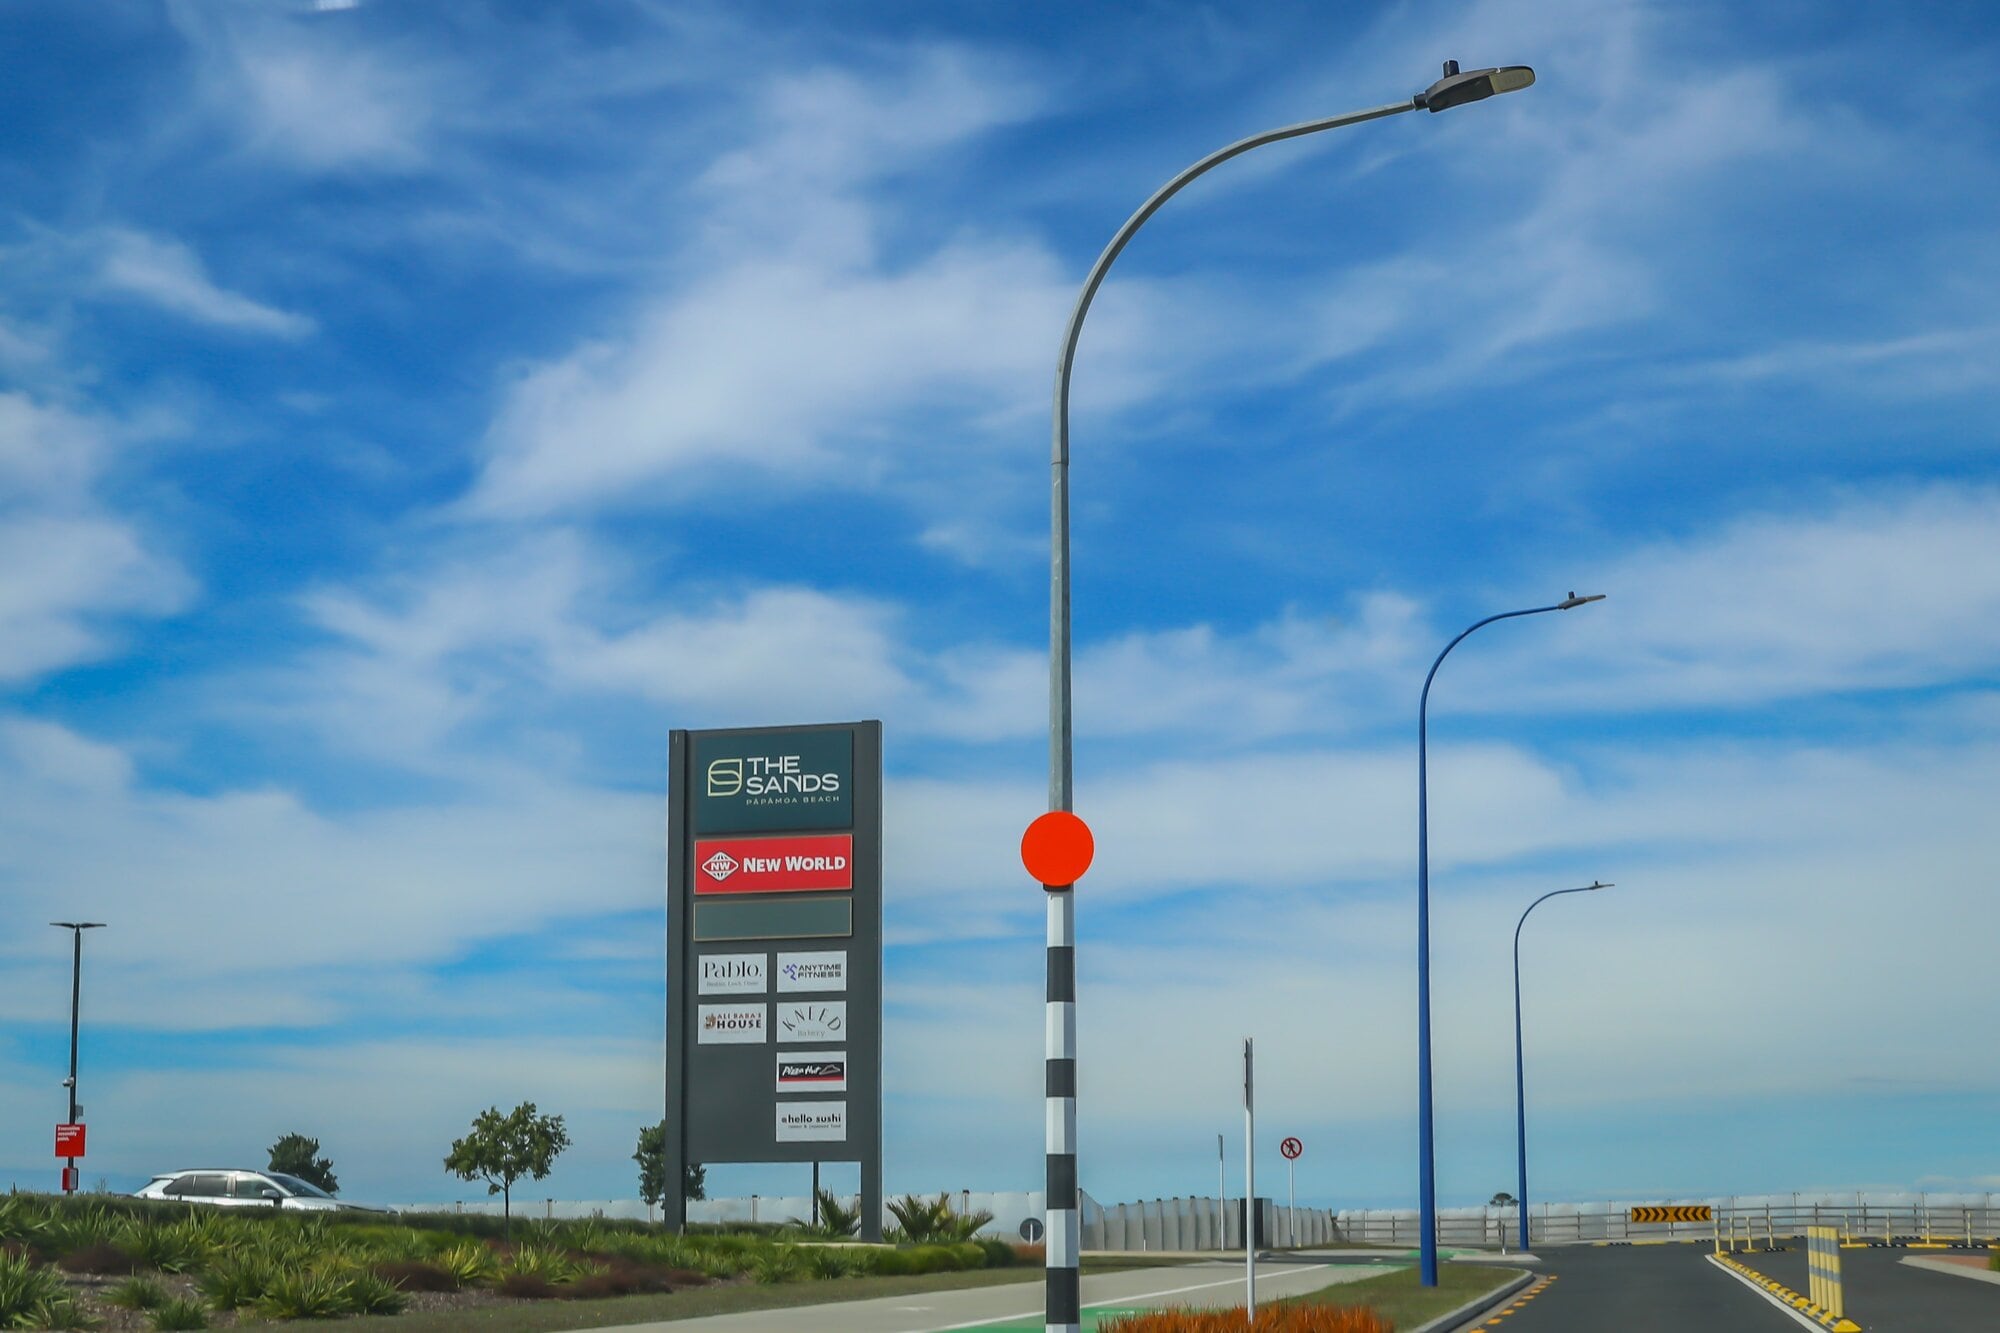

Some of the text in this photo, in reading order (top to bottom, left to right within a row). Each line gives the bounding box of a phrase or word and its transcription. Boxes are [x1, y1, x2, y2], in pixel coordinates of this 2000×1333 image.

[747, 755, 801, 775] THE
[746, 773, 840, 796] SANDS
[803, 795, 840, 804] BEACH
[710, 861, 730, 871] NW
[798, 963, 842, 971] ANYTIME
[798, 971, 842, 979] FITNESS
[717, 1019, 762, 1029] HOUSE
[782, 1065, 822, 1076] Pizza Hut
[788, 1113, 841, 1124] hello sushi
